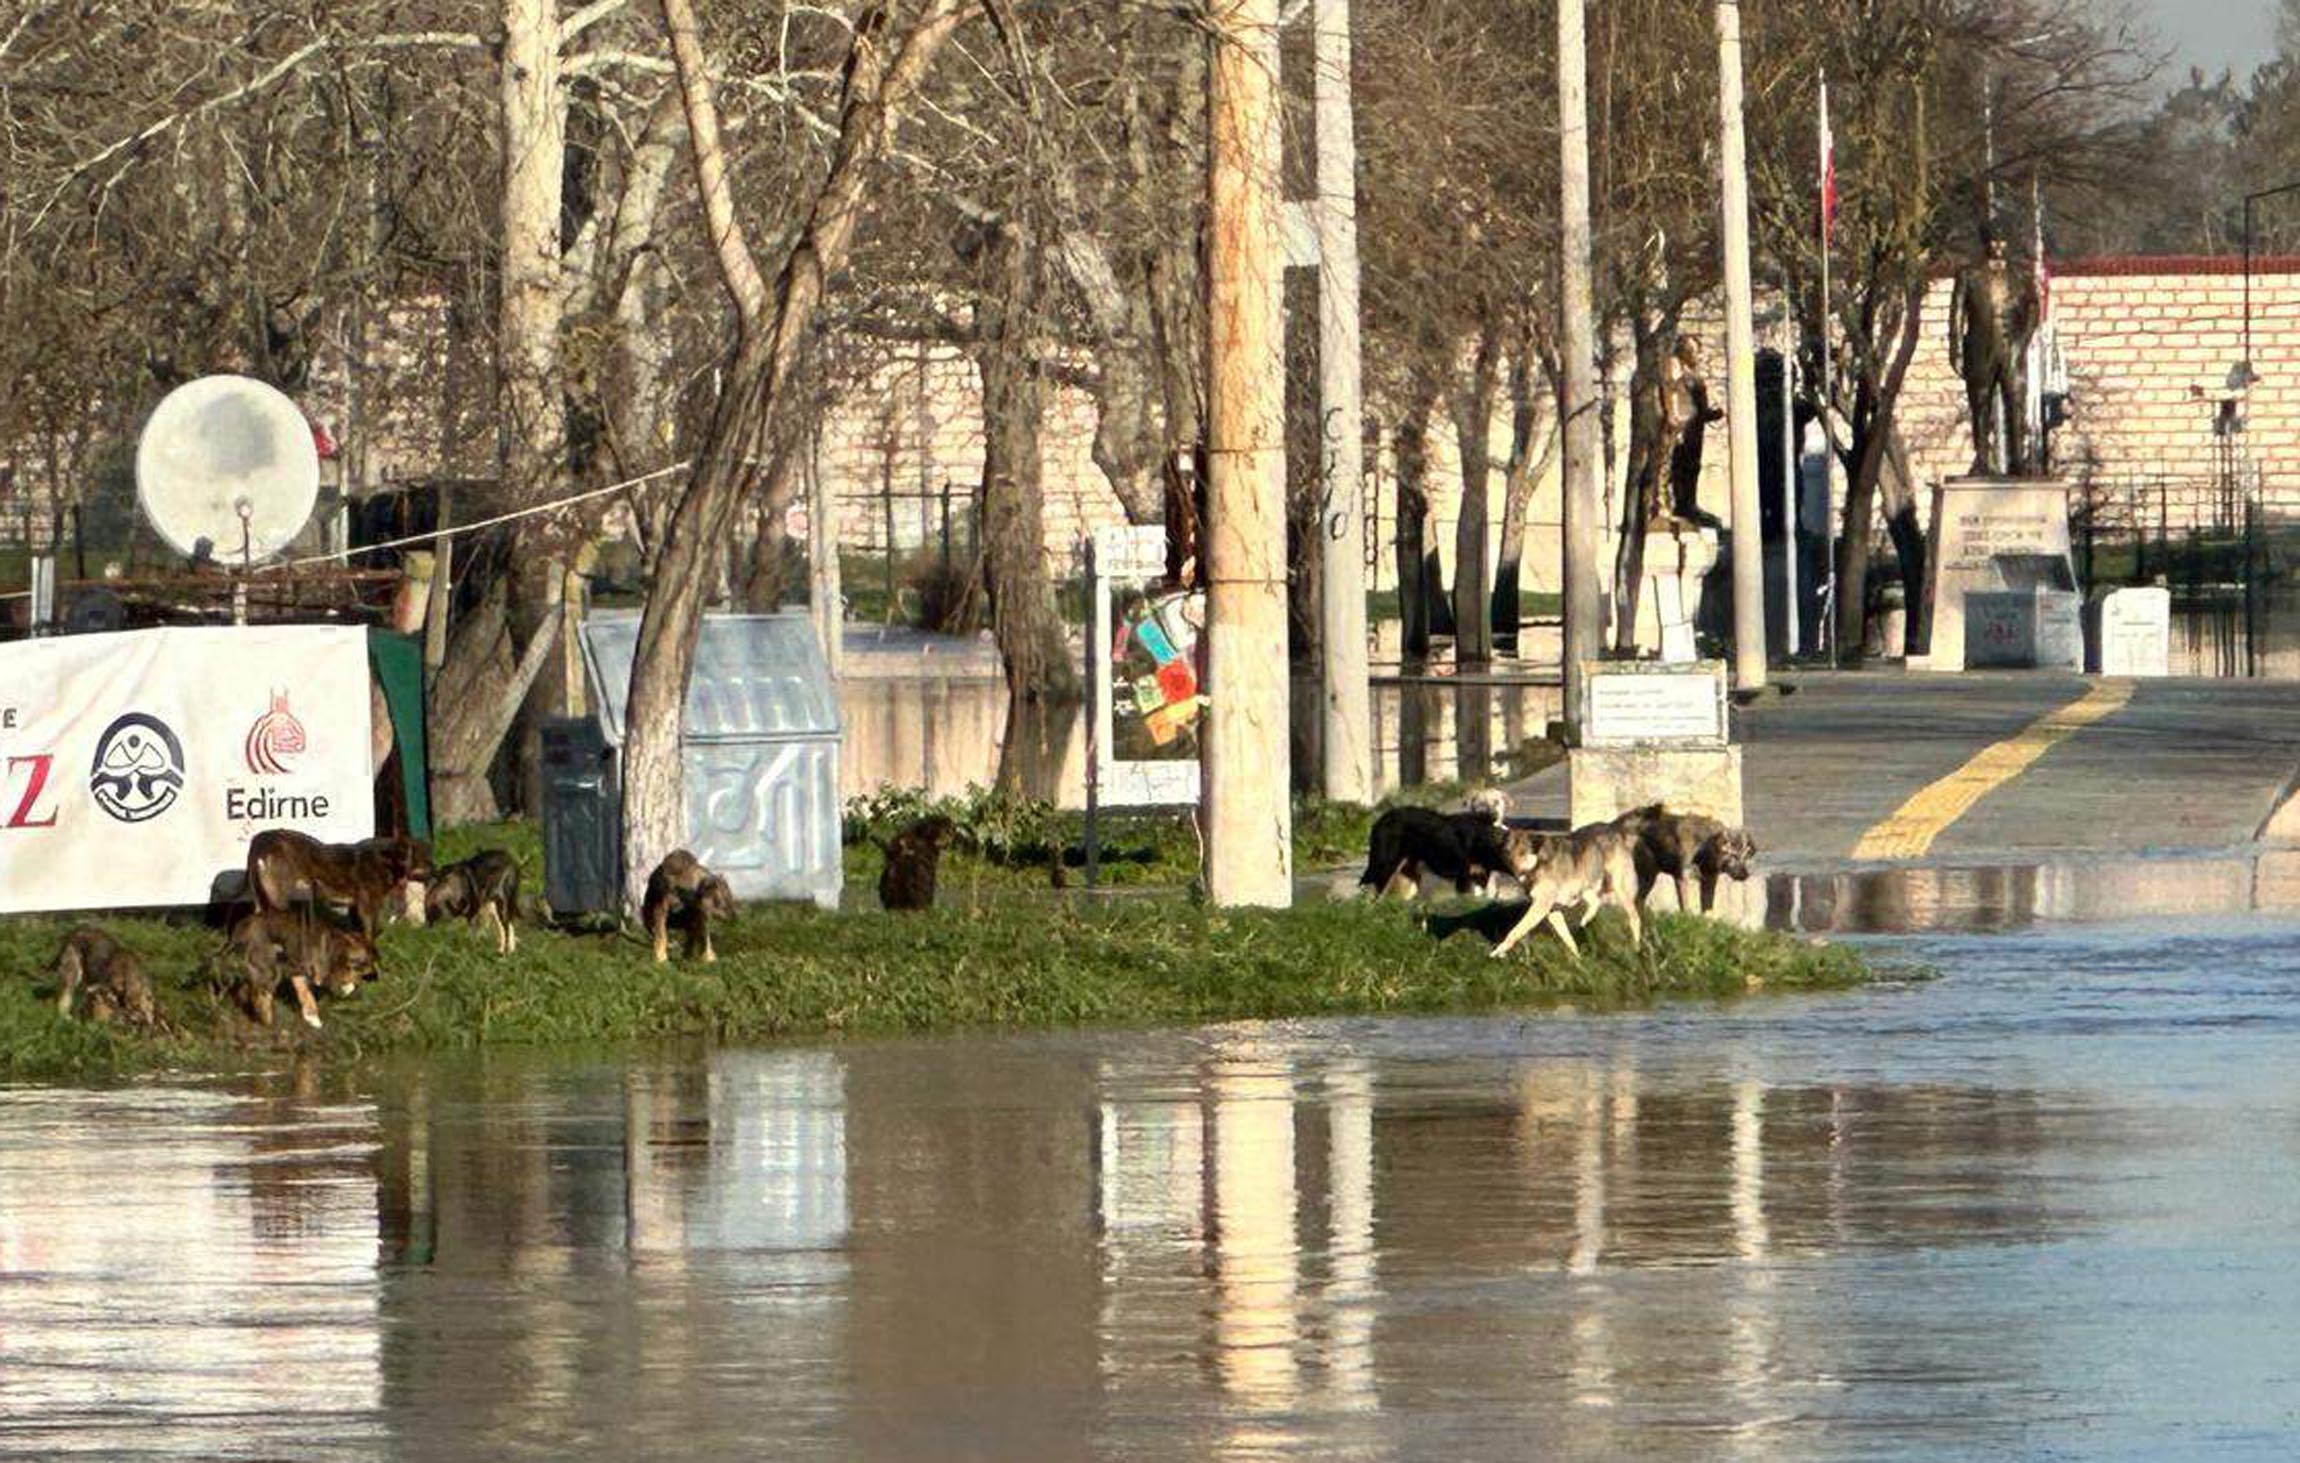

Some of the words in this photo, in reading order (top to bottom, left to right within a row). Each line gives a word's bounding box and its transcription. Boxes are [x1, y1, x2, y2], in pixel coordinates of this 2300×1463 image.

[0, 707, 18, 729] E
[0, 753, 59, 830] Z
[226, 787, 329, 820] Edirne
